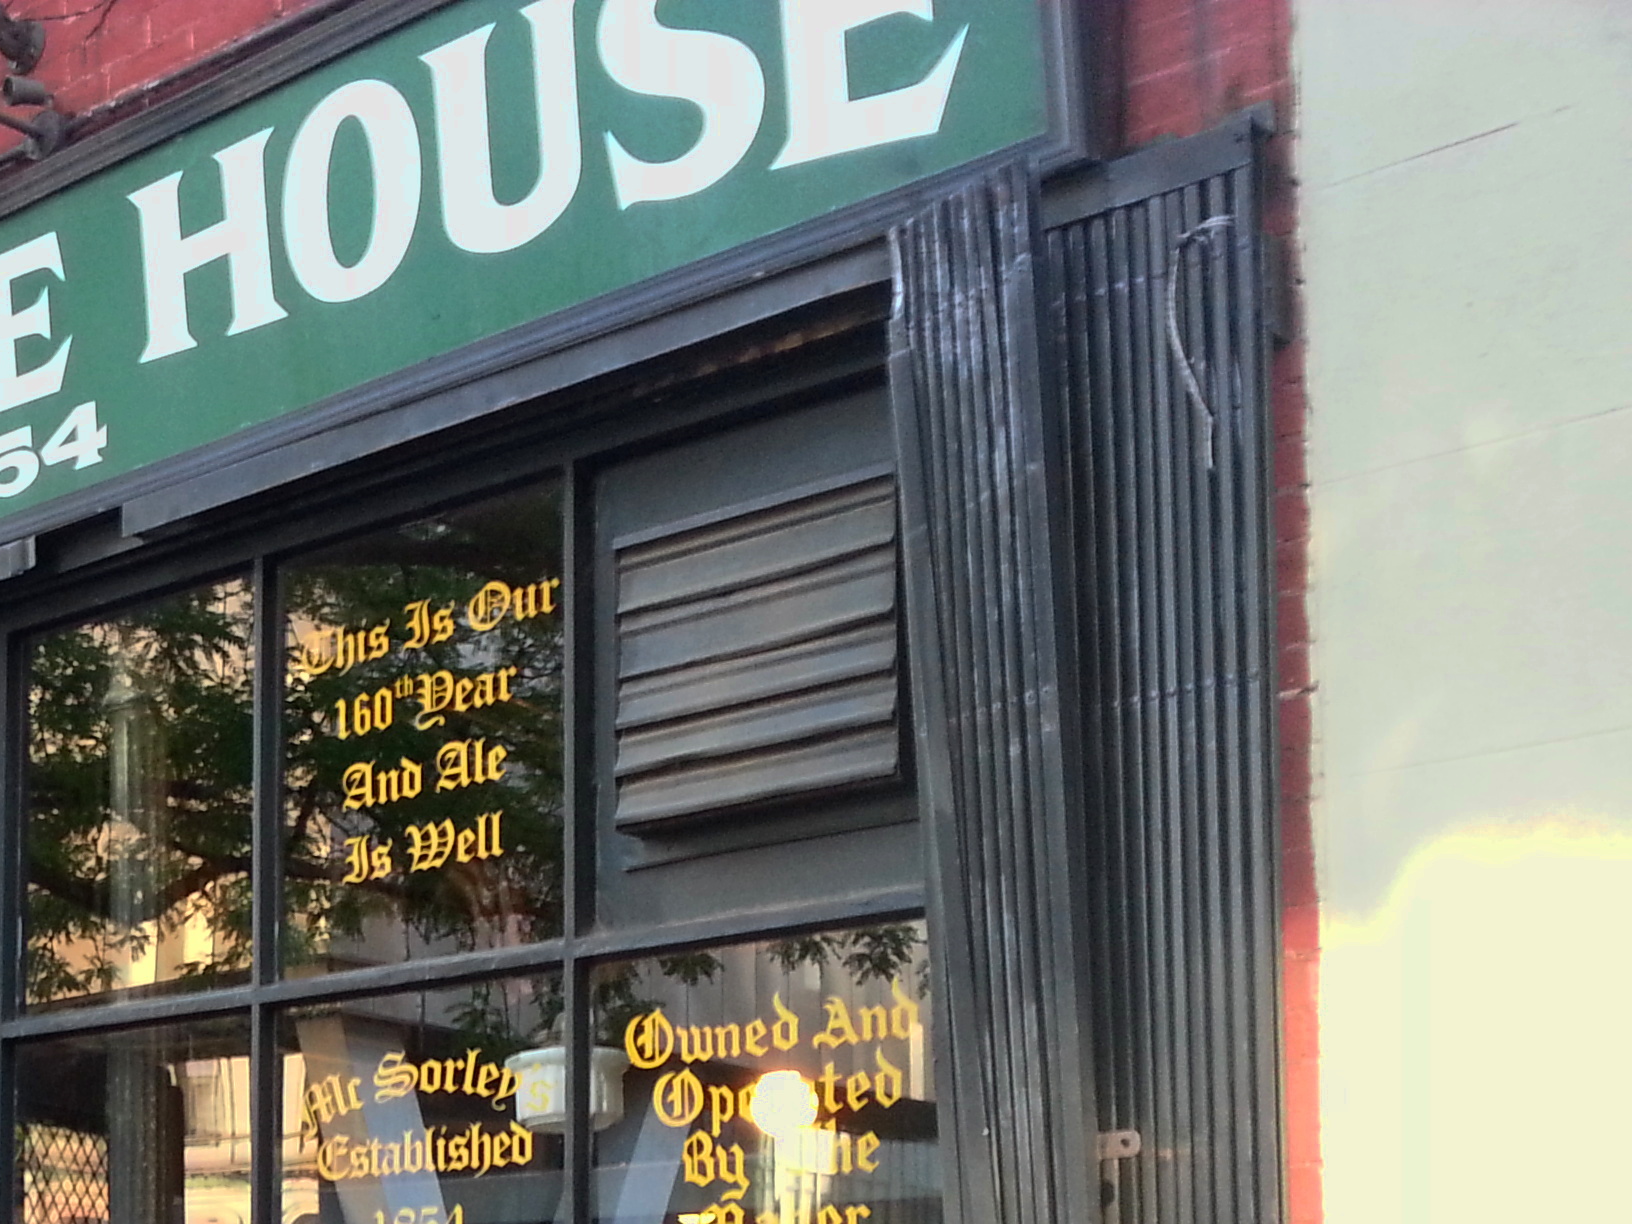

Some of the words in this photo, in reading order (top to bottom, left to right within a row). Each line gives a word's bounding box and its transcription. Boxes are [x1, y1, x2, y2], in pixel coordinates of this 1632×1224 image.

[126, 0, 969, 364] HOUSE
[301, 618, 390, 676] This
[403, 598, 456, 651] Is
[467, 577, 561, 632] Our
[413, 665, 517, 731] Year
[342, 756, 422, 812] And
[436, 737, 508, 793] Ale
[342, 835, 394, 885] Is
[404, 810, 505, 873] Well
[624, 991, 799, 1070] Owned
[812, 976, 920, 1049] And
[299, 1071, 365, 1153] Mc
[373, 1047, 555, 1112] Sorley's
[653, 1046, 903, 1138] Opeted
[318, 1119, 534, 1180] Established
[682, 1129, 750, 1202] By
